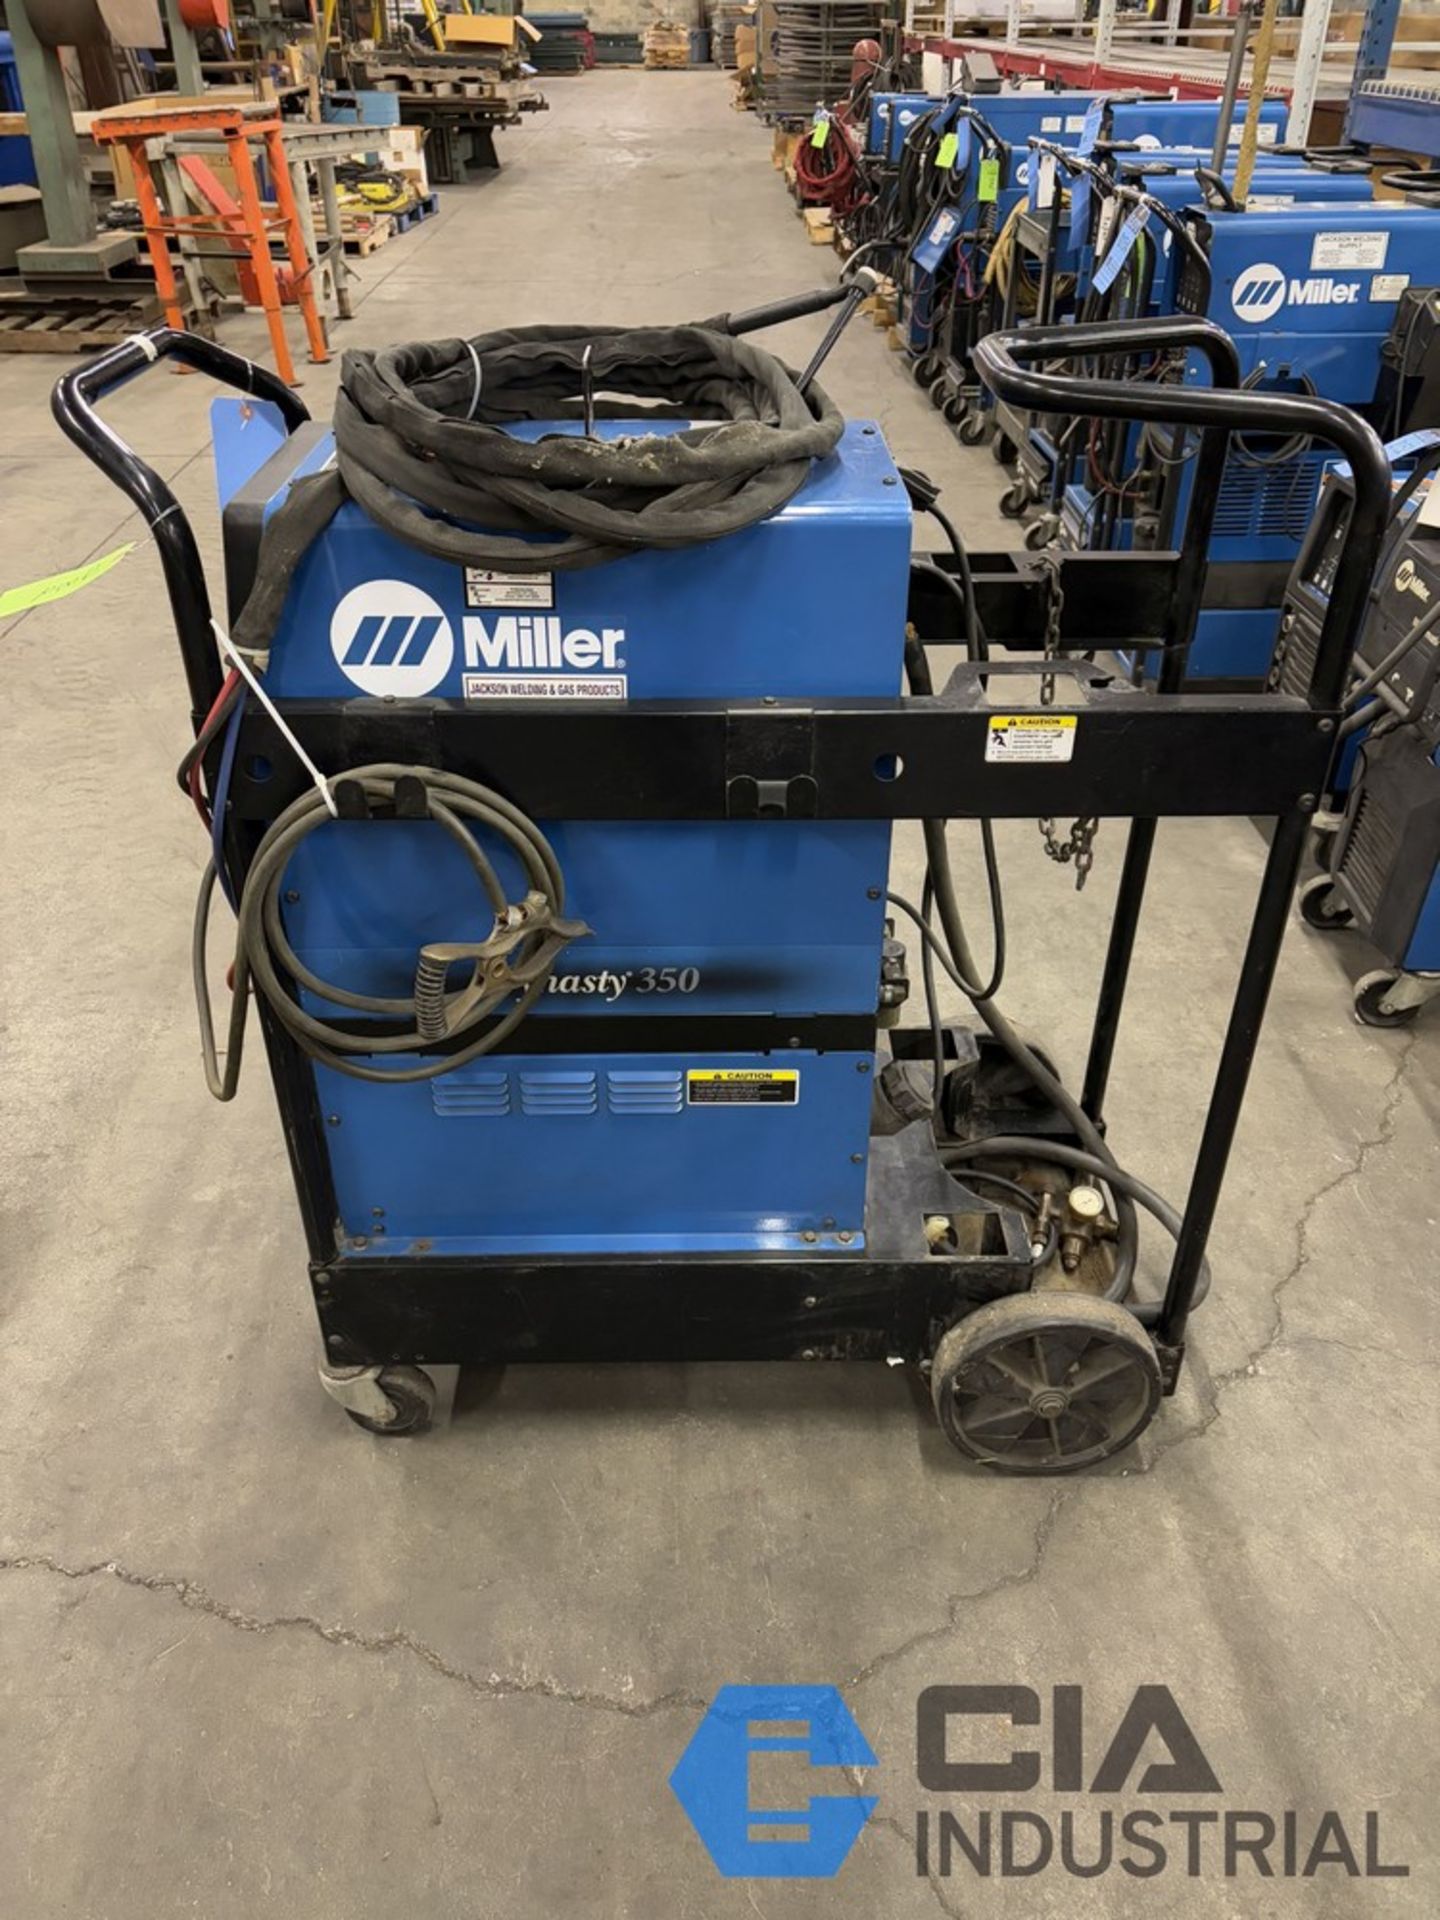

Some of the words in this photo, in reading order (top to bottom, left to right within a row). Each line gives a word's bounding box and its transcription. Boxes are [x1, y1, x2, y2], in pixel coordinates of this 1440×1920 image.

[1287, 278, 1360, 305] Miller
[470, 683, 508, 696] JACKSON
[510, 683, 548, 696] WELDING
[550, 684, 557, 696] &
[558, 684, 575, 696] GAS
[577, 684, 621, 697] PRODUCTS
[1019, 718, 1061, 726] CAUTION
[635, 967, 700, 993] 350
[727, 1072, 773, 1080] CAUTION
